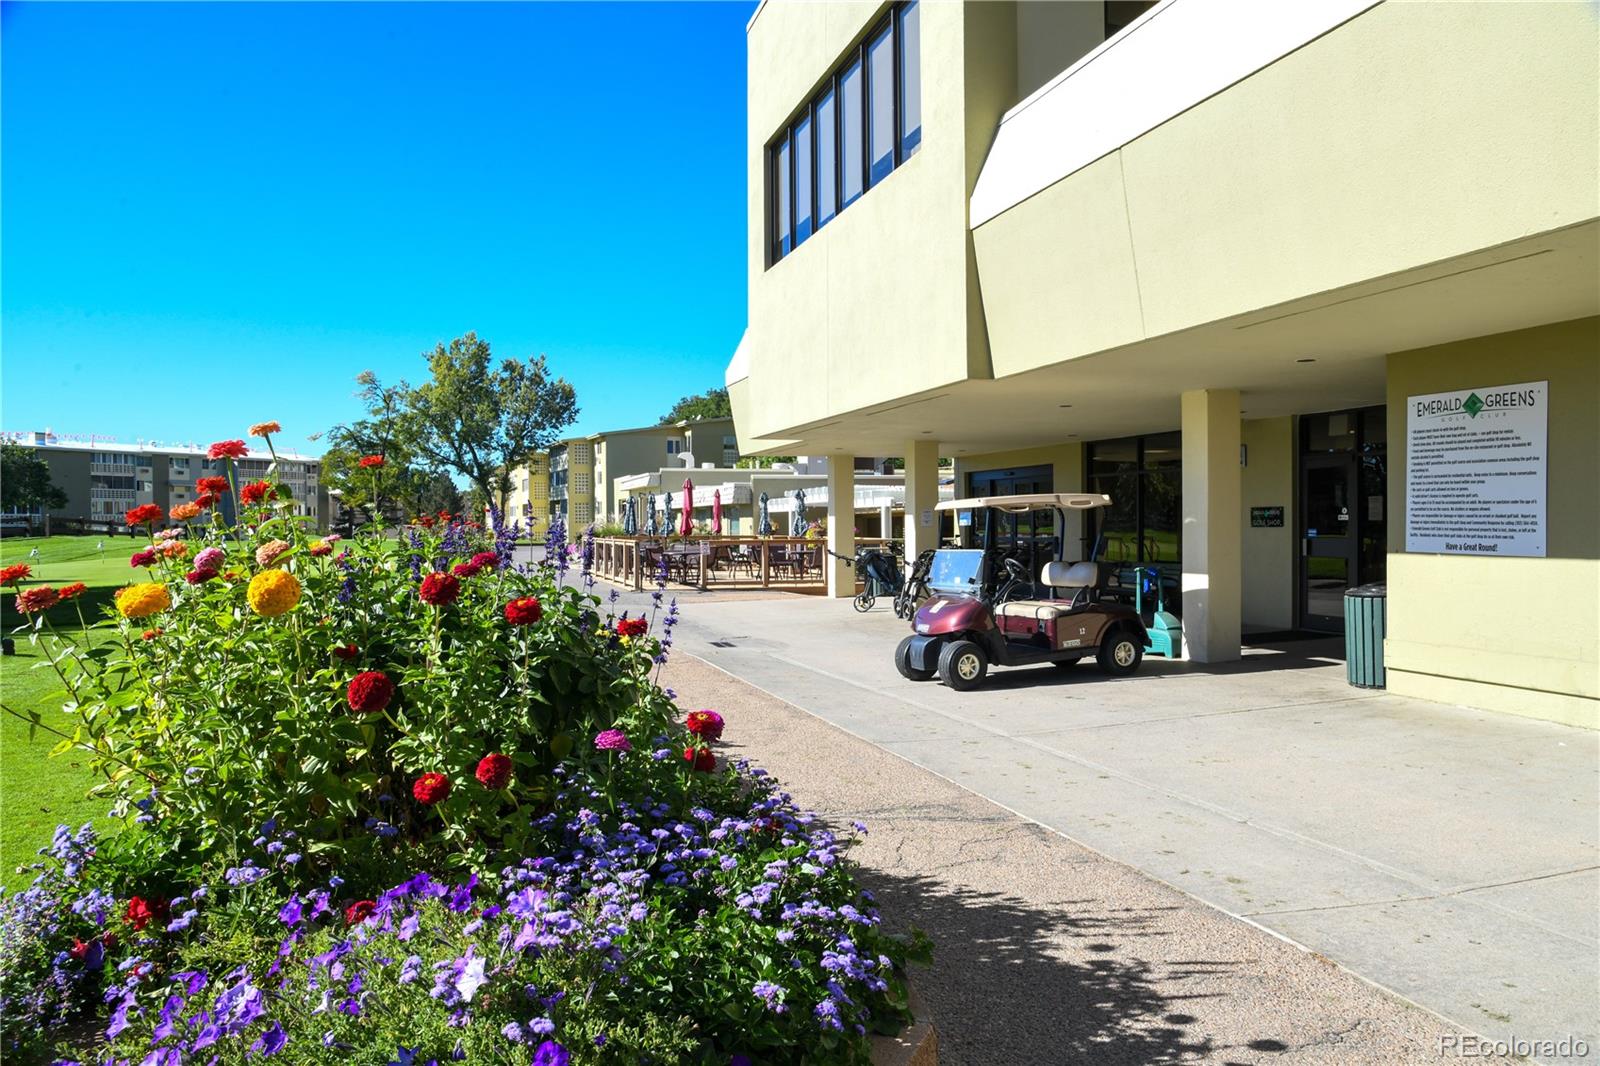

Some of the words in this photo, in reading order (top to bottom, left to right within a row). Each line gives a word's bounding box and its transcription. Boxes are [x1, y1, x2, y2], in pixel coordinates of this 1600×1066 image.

[1416, 398, 1462, 417] EMERALD
[1485, 390, 1535, 407] GREENS
[1480, 412, 1507, 420] CLUB
[1445, 542, 1458, 551] Have
[1463, 542, 1478, 552] Great
[1478, 543, 1498, 552] Round!
